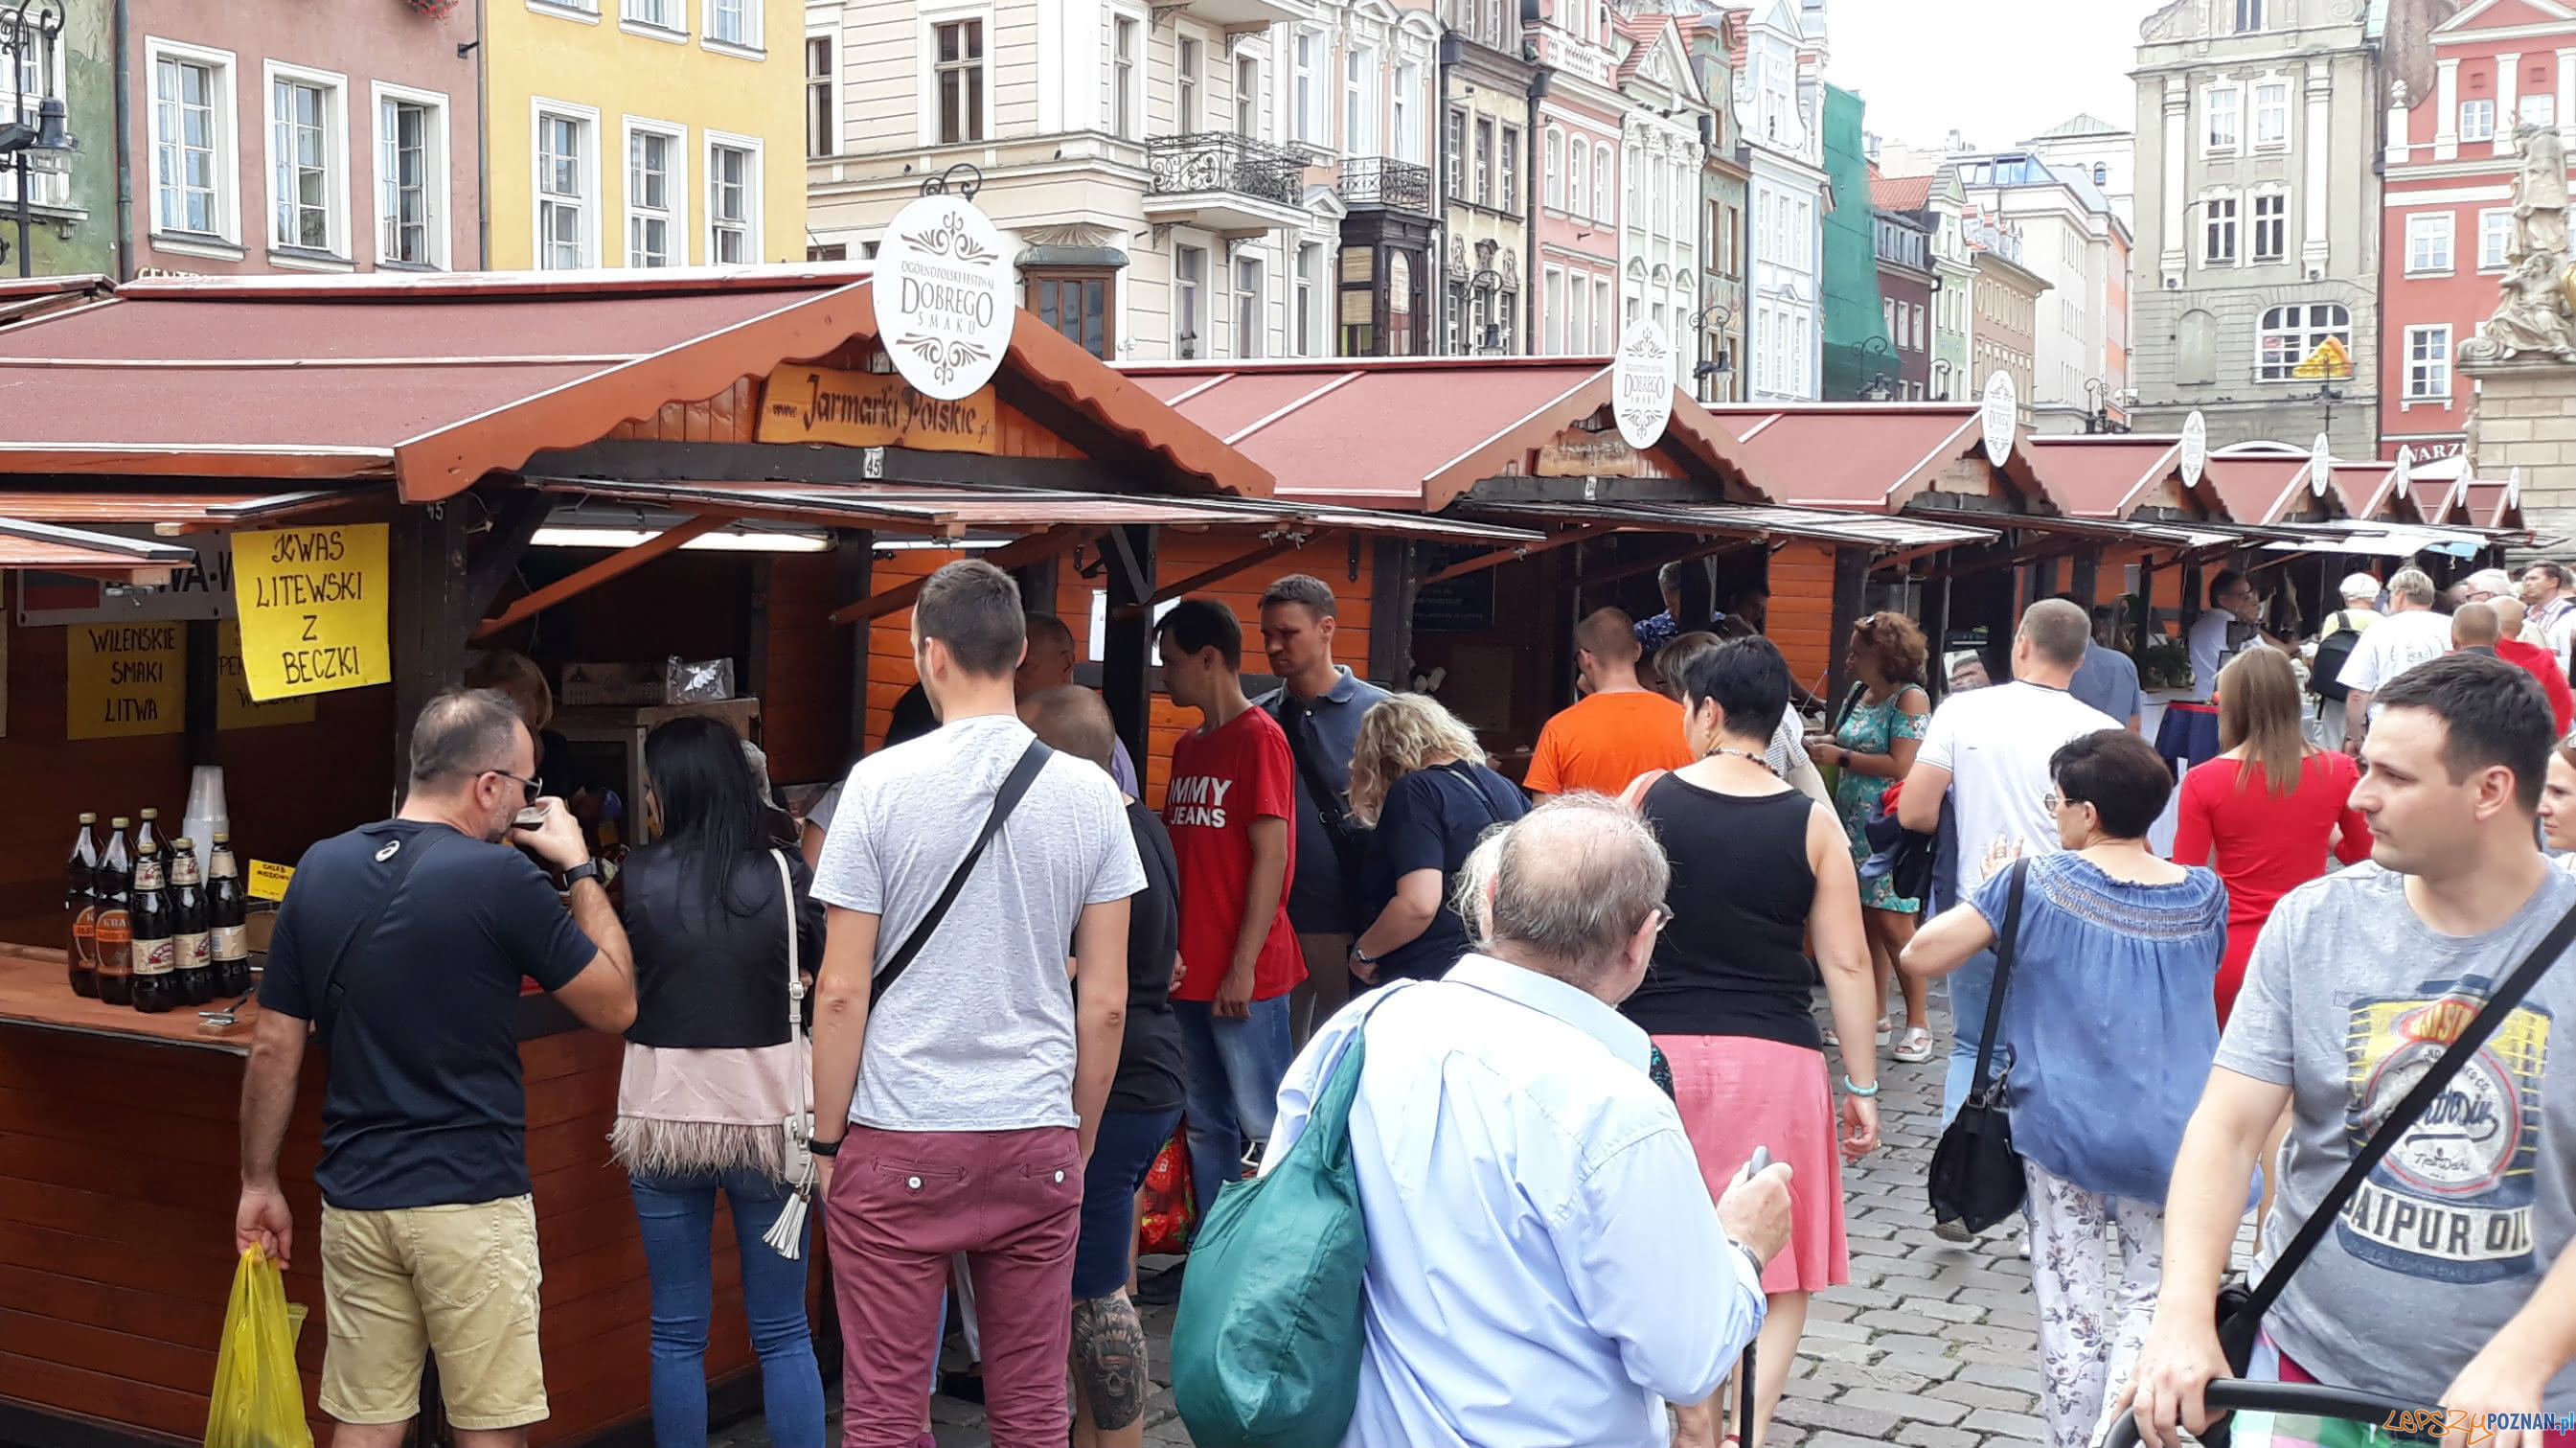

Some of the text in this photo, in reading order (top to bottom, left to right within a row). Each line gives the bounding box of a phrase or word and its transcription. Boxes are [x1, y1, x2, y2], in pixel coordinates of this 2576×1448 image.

[901, 276, 993, 328] DOBREGO
[918, 311, 975, 334] SMAKU
[803, 373, 899, 431] Jarmarki
[901, 385, 976, 436] Polskie
[866, 457, 880, 475] 45
[256, 572, 363, 608] LITEWSKI
[302, 615, 318, 641] Z
[111, 660, 163, 684] SMAKI
[283, 646, 360, 685] BECZKI
[104, 699, 158, 722] LITWA
[1171, 806, 1226, 828] JEANS
